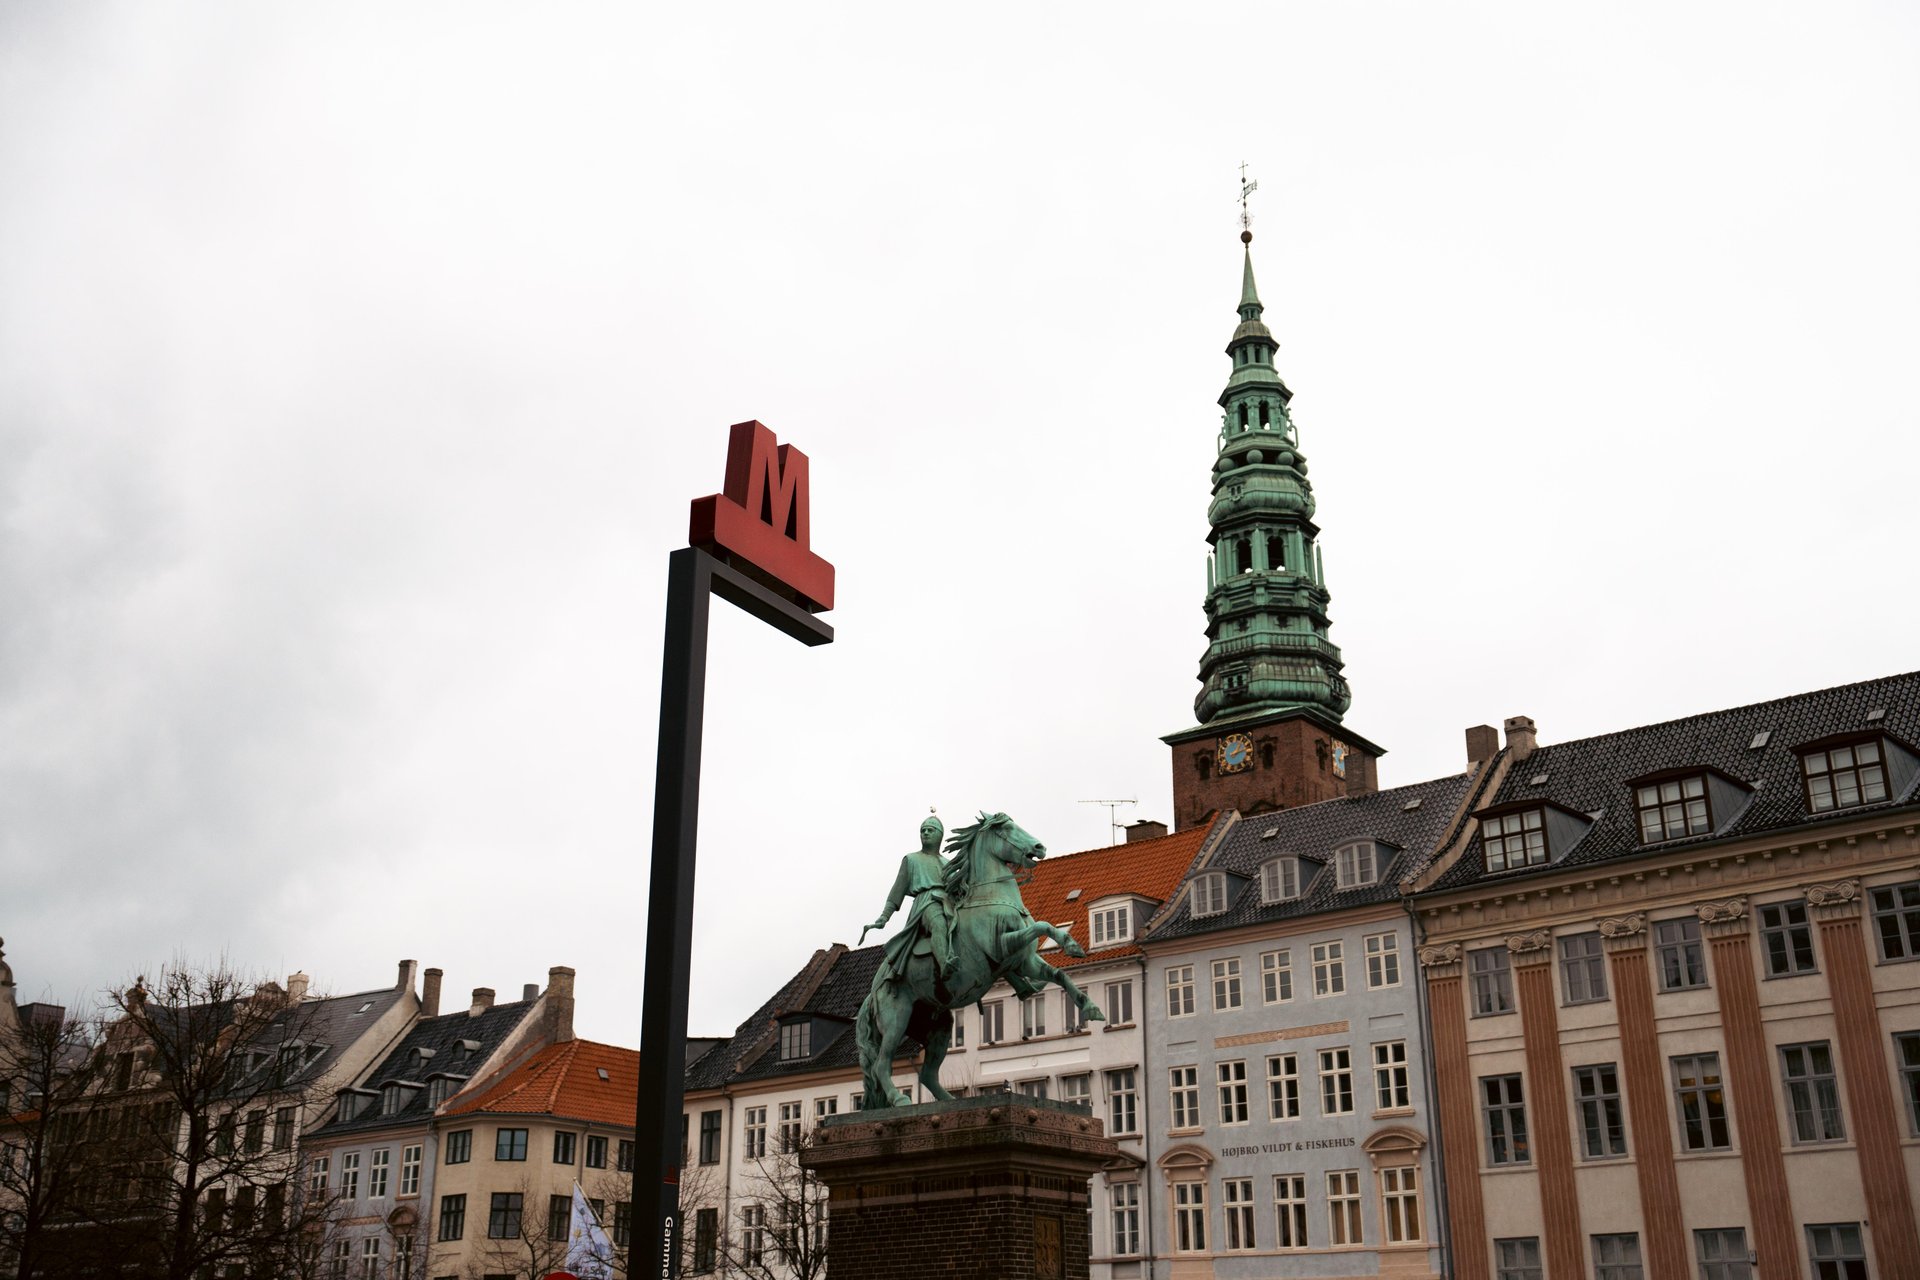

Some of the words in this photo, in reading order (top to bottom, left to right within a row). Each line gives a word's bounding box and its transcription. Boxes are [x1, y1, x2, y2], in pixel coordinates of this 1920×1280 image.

[1221, 1145, 1259, 1157] HØJBRO
[1262, 1142, 1292, 1153] VILDT
[1295, 1141, 1303, 1151] &
[1305, 1137, 1355, 1150] FISKEHUS
